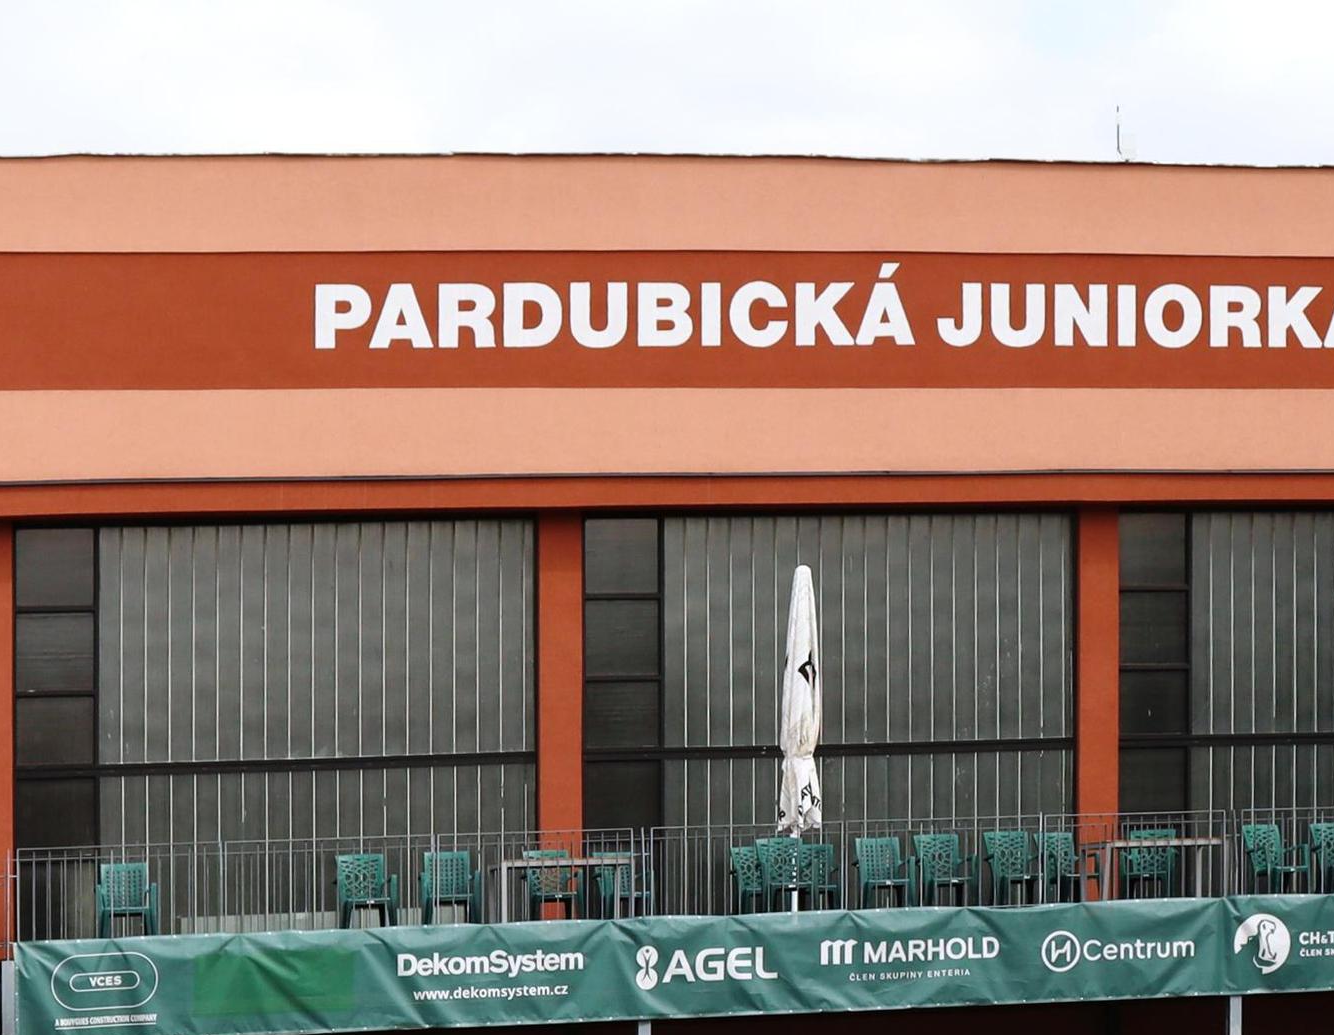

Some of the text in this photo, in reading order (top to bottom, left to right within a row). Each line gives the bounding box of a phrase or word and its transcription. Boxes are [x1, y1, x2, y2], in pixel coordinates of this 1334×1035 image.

[313, 263, 917, 350] PARDUBICKÁ
[863, 936, 1000, 965] MARHOLD
[1083, 938, 1195, 962] Centrum
[1299, 947, 1323, 957] ČLEN
[396, 949, 584, 978] DekomSystem
[662, 946, 779, 984] AGEL
[848, 968, 971, 982] ČLEN SKUPINY ENTERIA
[89, 975, 123, 988] VCES
[413, 984, 569, 1001] www.dekomsystem.cz
